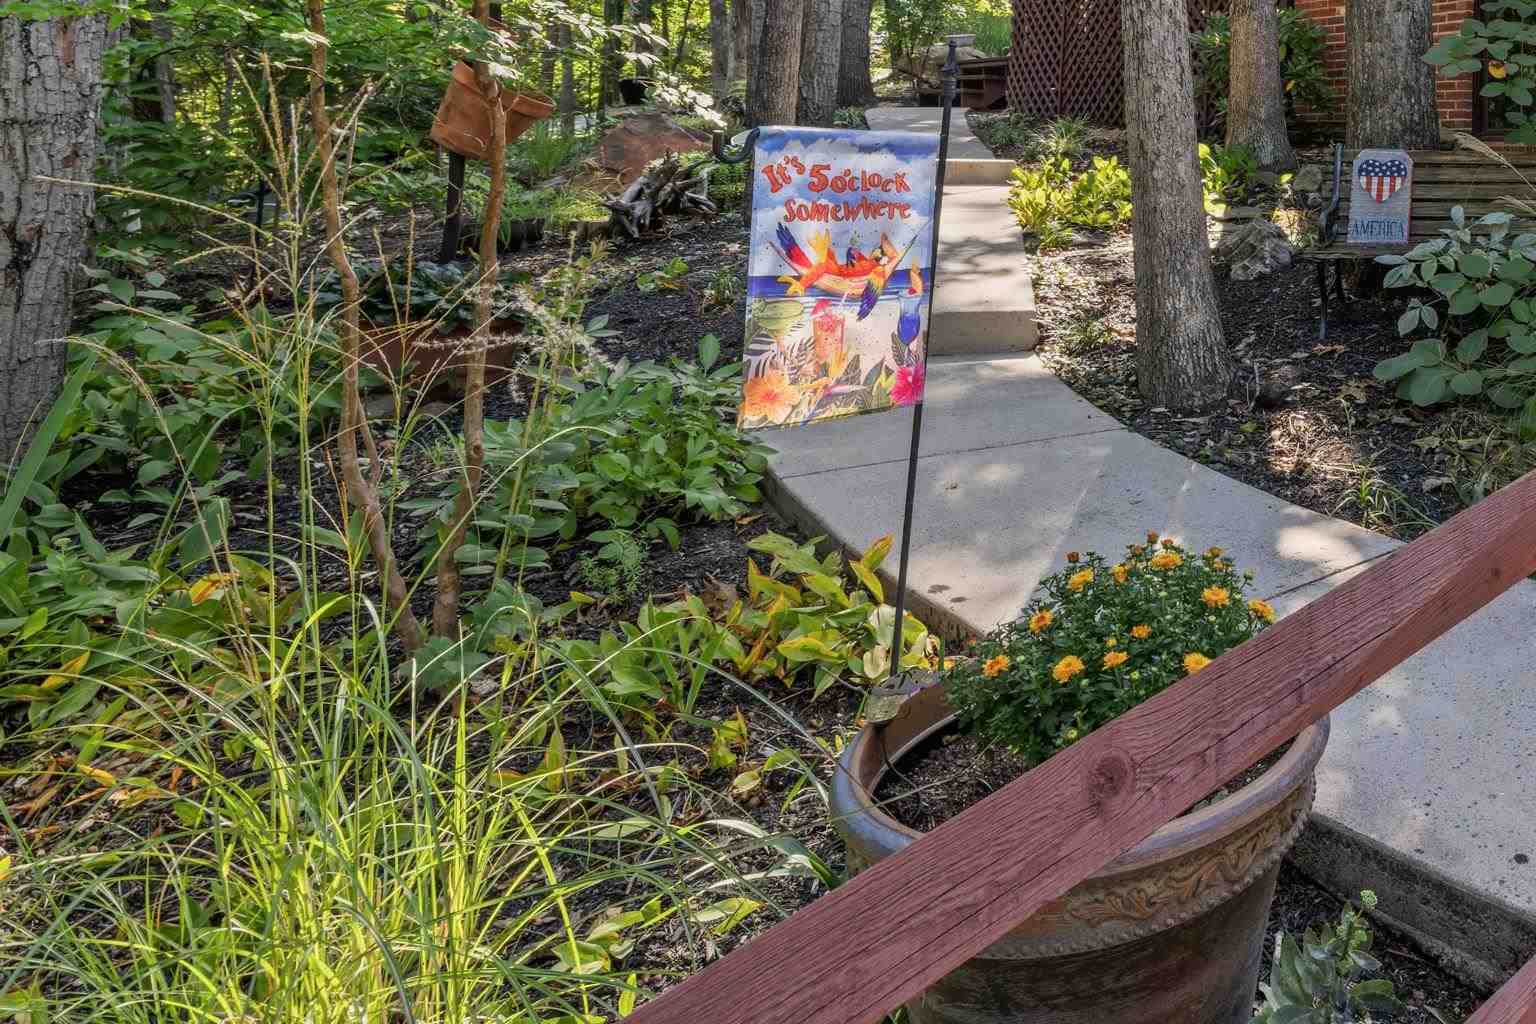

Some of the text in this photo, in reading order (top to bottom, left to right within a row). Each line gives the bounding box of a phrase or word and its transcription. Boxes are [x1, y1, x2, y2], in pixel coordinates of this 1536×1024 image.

[761, 155, 805, 193] It's
[807, 164, 831, 193] 5
[1351, 219, 1404, 239] AMERICA
